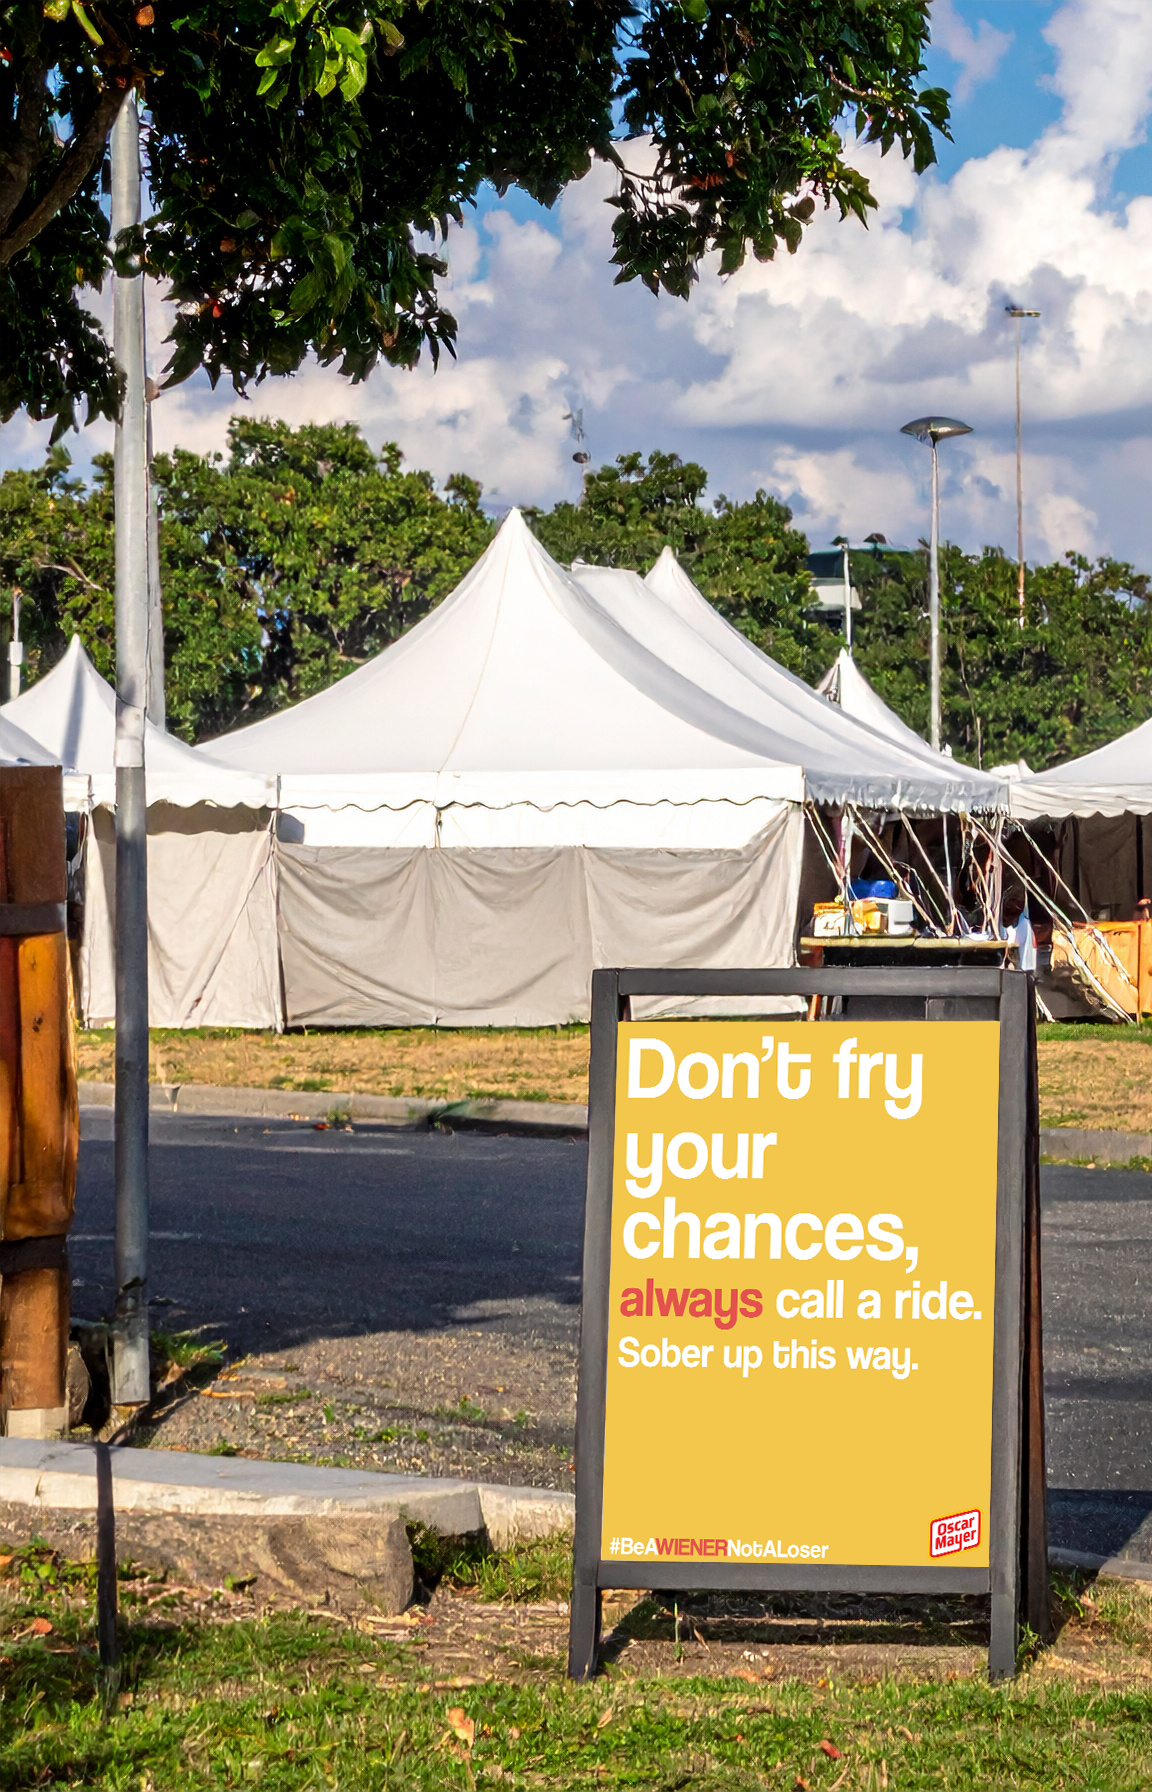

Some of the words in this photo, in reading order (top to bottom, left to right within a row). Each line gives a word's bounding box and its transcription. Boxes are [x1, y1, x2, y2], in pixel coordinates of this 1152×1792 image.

[628, 1036, 811, 1099] Don't
[833, 1037, 923, 1119] fry
[625, 1132, 777, 1198] your
[623, 1196, 918, 1274] chances,
[620, 1278, 763, 1330] always
[776, 1280, 844, 1319] call
[857, 1290, 881, 1319] a
[895, 1281, 982, 1320] ride.
[618, 1336, 714, 1368] Sober
[724, 1346, 763, 1378] up
[773, 1339, 836, 1369] this
[846, 1347, 918, 1379] way.
[609, 1537, 829, 1559] #BeAWIENERNotALoser
[935, 1530, 976, 1550] Mayer
[938, 1517, 975, 1536] Oscar
